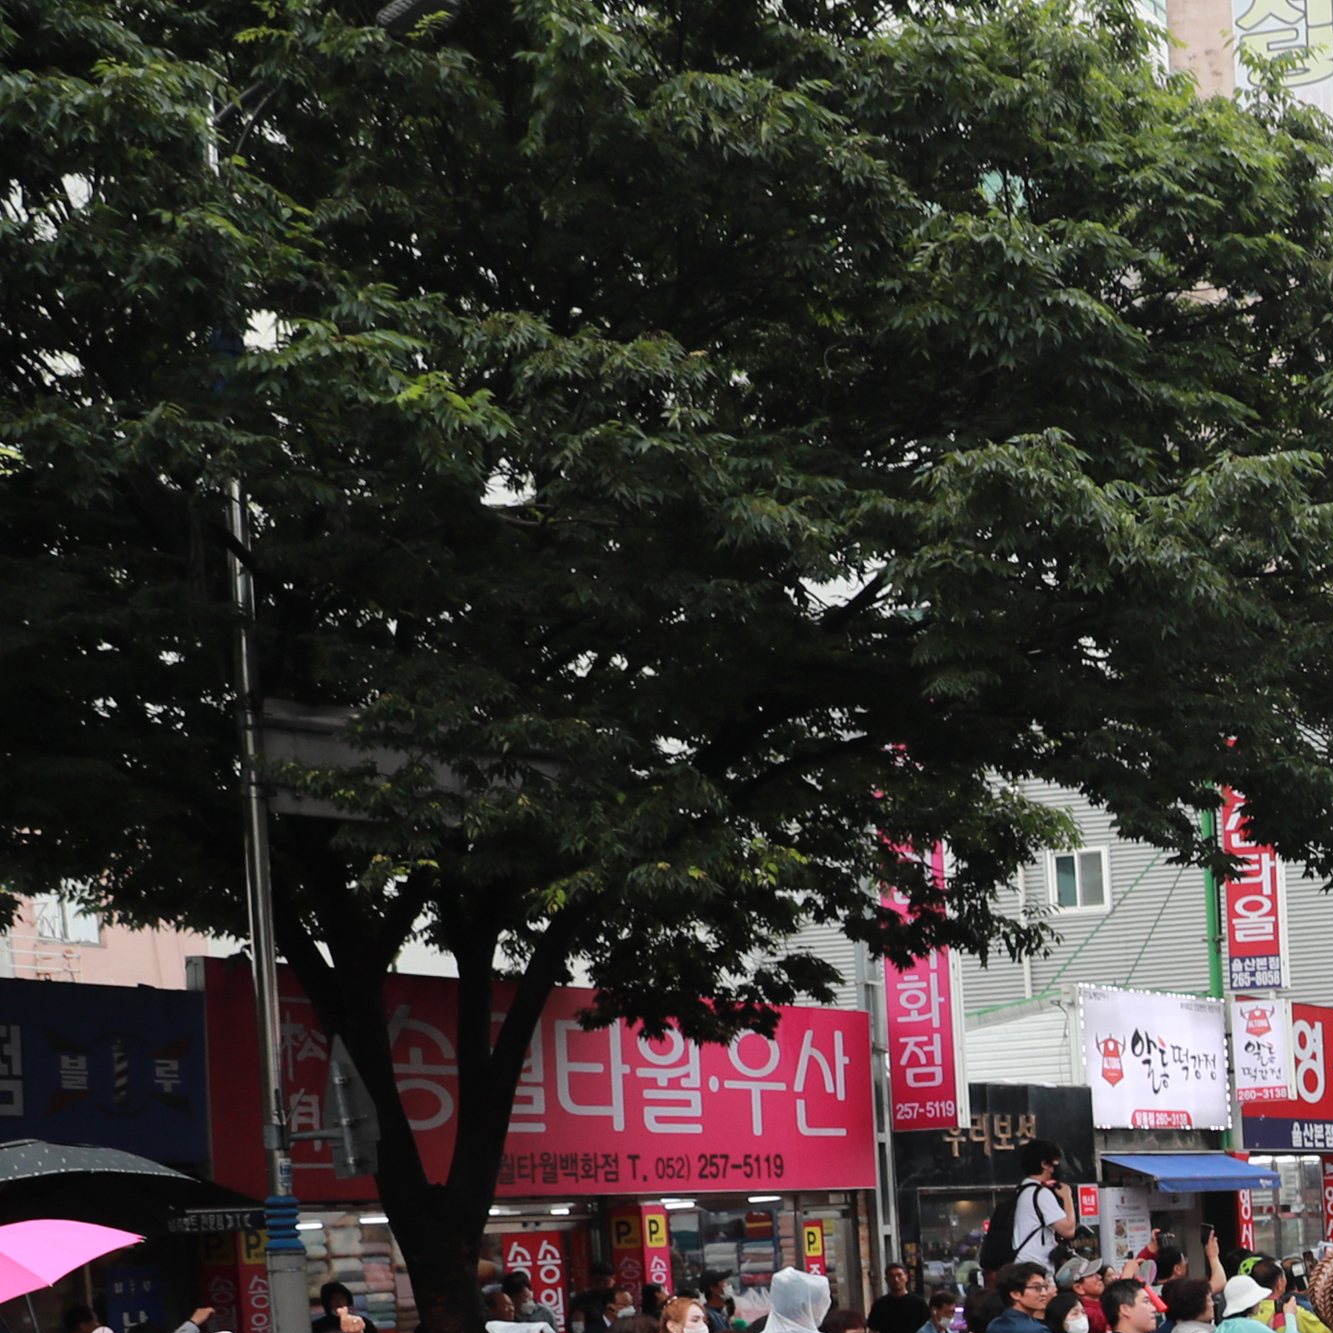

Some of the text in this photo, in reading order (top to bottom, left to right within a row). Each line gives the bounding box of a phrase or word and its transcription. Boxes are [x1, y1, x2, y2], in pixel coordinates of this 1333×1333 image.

[1231, 971, 1282, 989] 265-8058
[1237, 1087, 1289, 1101] 260-3138
[895, 1100, 956, 1121] 257-5119
[1156, 1111, 1188, 1127] 260-3138
[499, 1151, 620, 1185] 월타월백화점
[655, 1156, 692, 1180] 052)
[697, 1152, 786, 1180] 257-5119
